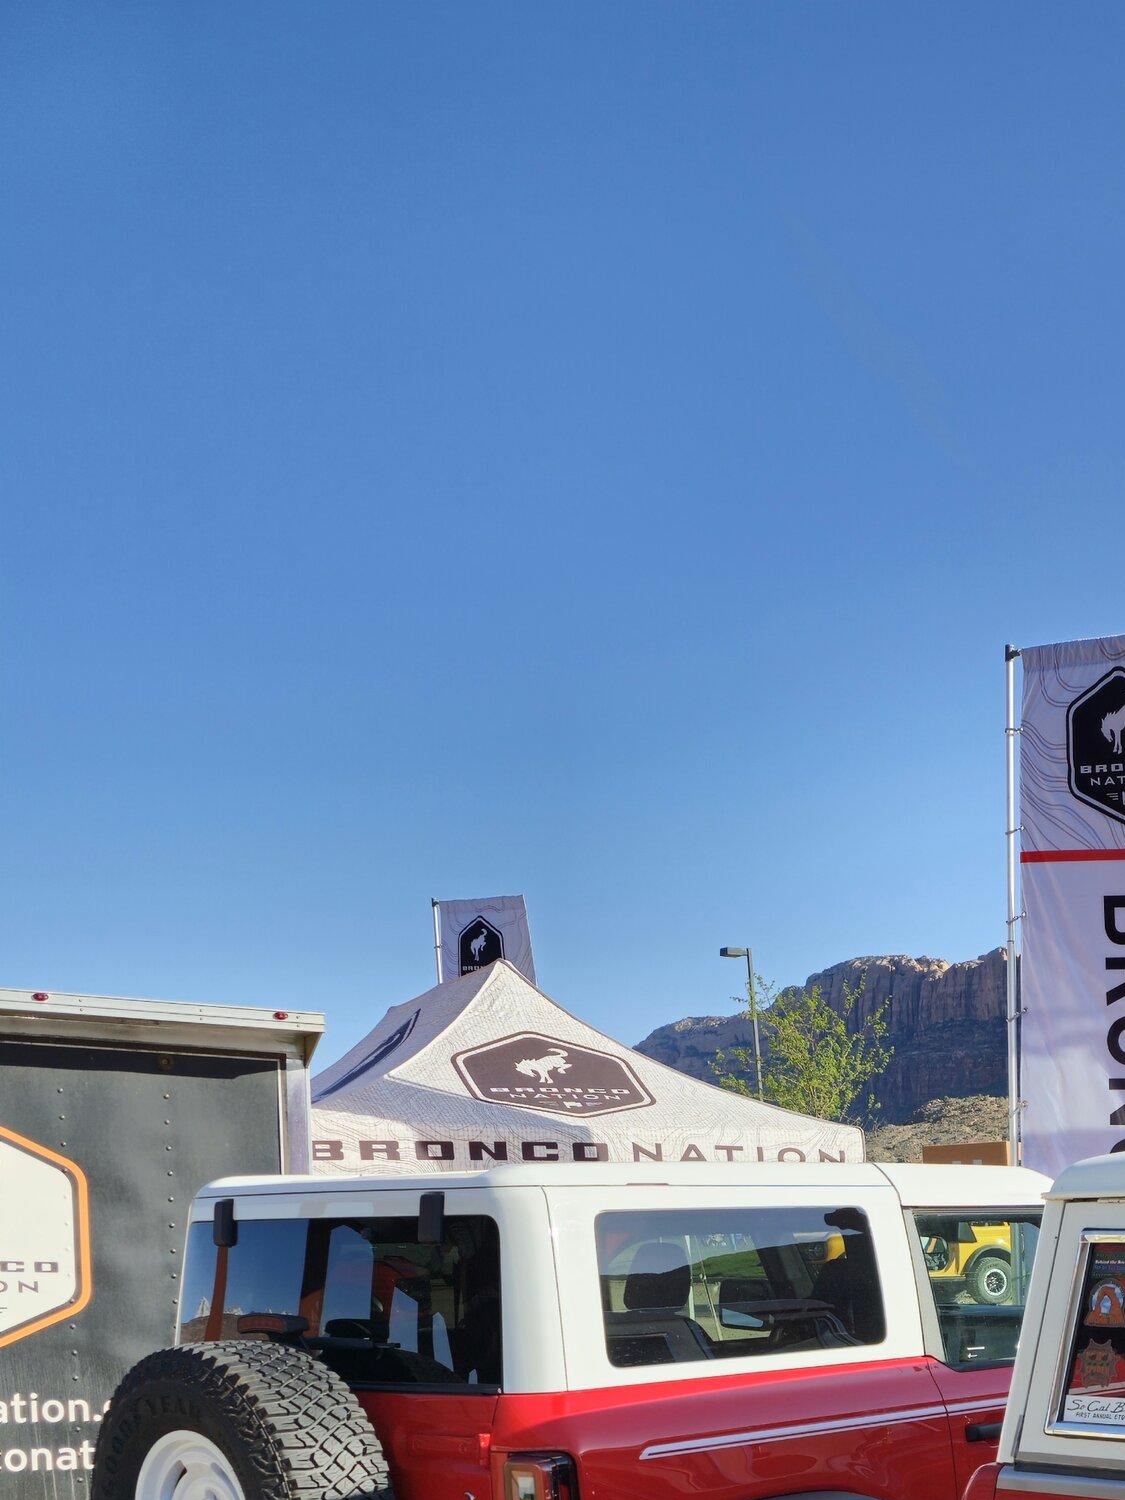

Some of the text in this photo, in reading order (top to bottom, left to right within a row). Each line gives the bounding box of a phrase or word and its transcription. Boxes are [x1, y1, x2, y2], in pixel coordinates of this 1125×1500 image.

[489, 1087, 631, 1095] BRONCO
[508, 1093, 622, 1101] NATION
[311, 1140, 846, 1163] BRONCO NATION
[1087, 1401, 1110, 1412] Cal
